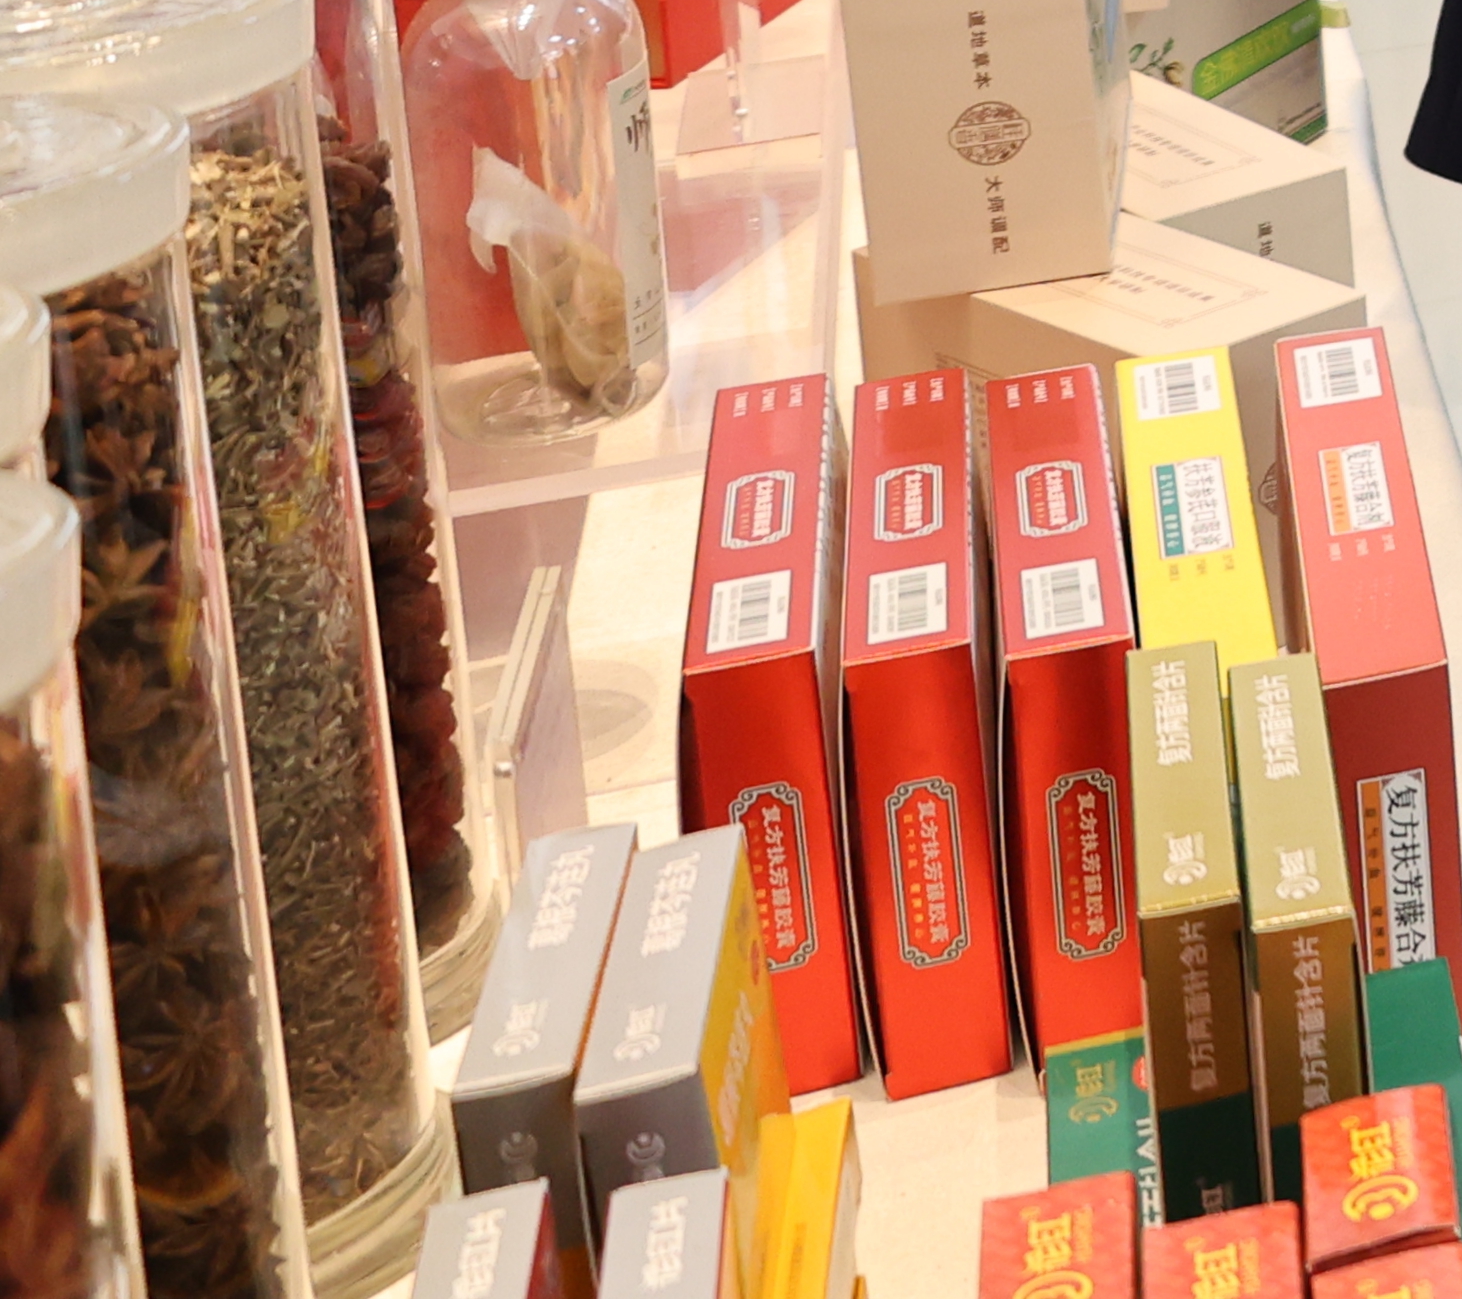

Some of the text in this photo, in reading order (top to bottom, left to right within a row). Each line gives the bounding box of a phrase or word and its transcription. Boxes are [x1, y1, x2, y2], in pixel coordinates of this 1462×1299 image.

[967, 10, 993, 90] 道地草本
[984, 175, 1012, 254] 大师调配
[1151, 659, 1193, 767] 复方两面针含片
[1254, 673, 1300, 781] 复方两面针含片
[760, 803, 797, 950] 复方扶芳藤胶囊
[916, 798, 951, 945] 复方扶芳藤胶囊
[1076, 790, 1107, 937] 复方扶芳藤胶囊
[1177, 920, 1219, 1092] 复方两面针含片
[1292, 934, 1332, 1109] 复方两面针含片
